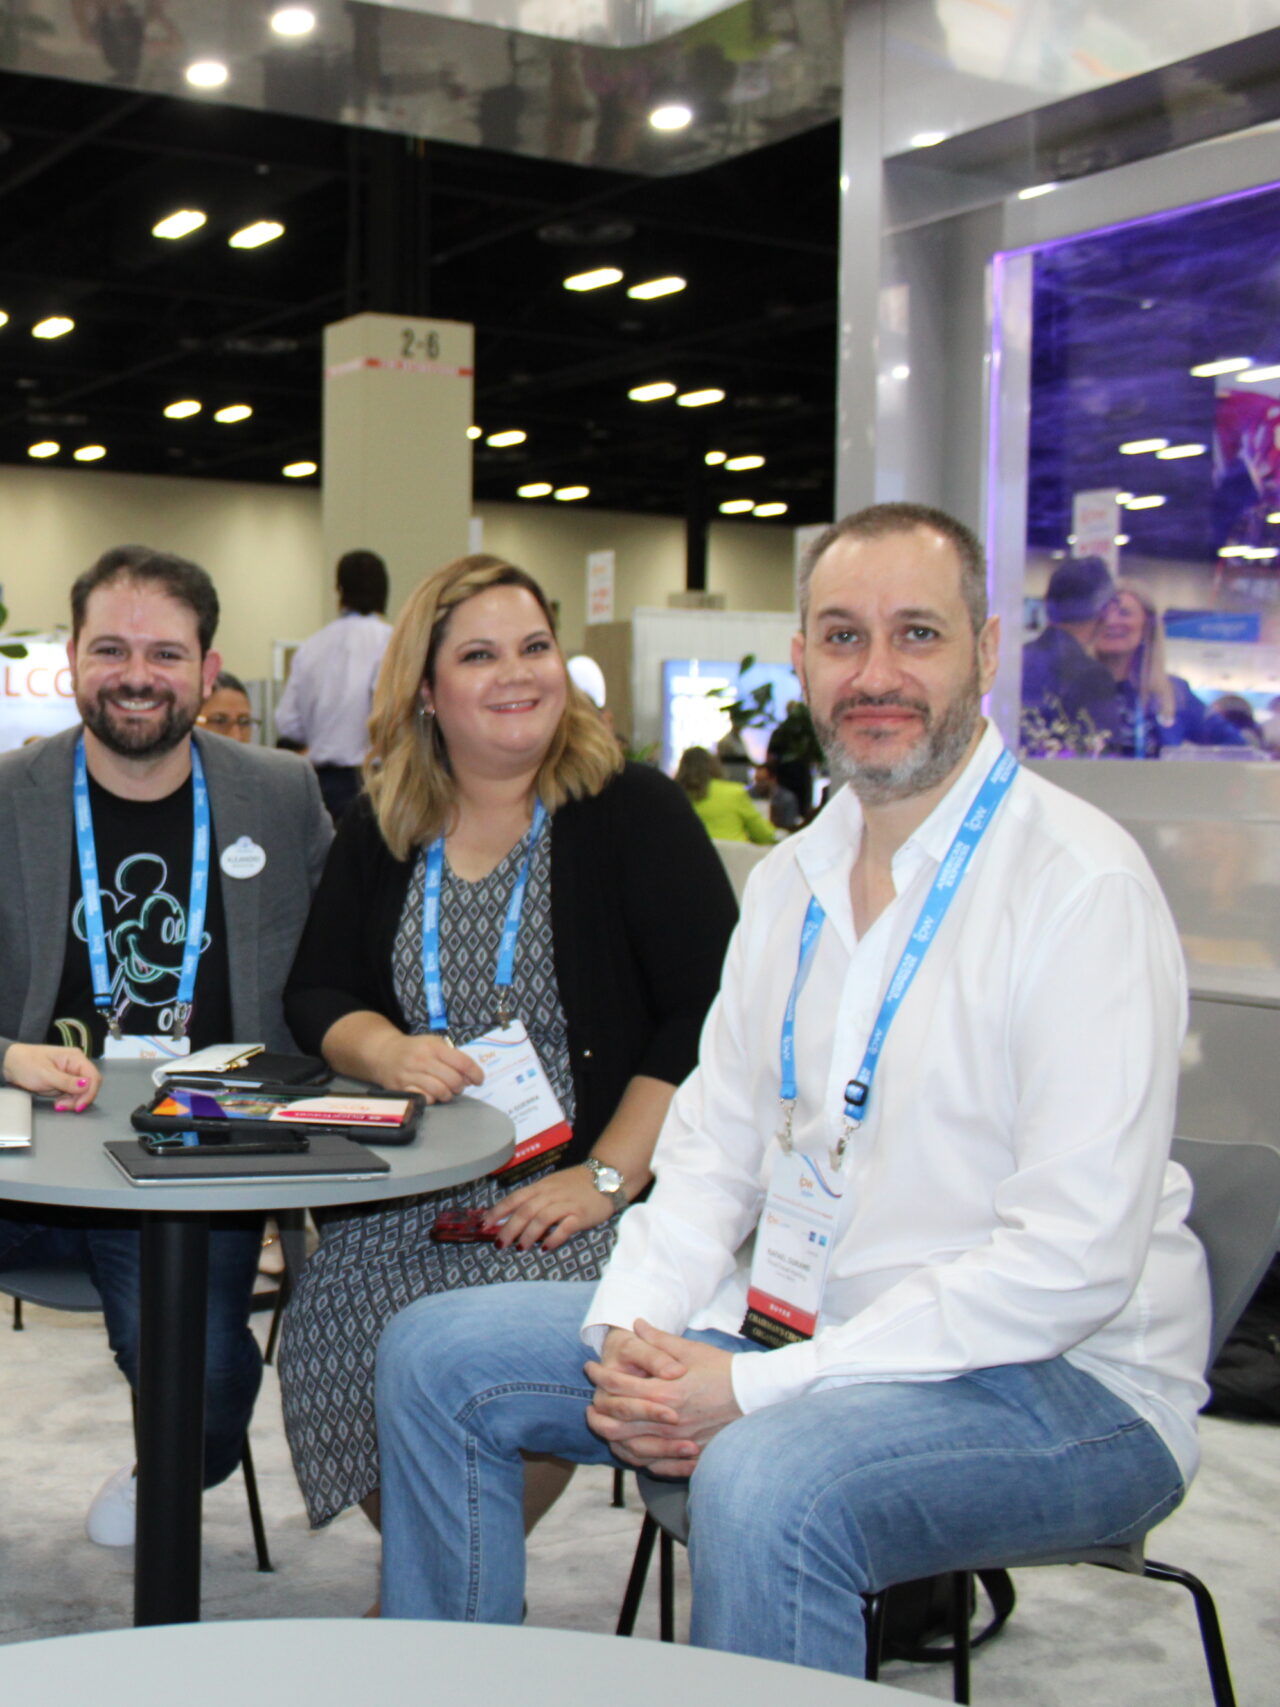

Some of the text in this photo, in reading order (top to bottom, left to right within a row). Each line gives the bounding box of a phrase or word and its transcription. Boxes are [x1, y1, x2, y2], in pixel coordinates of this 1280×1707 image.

[401, 328, 440, 360] 2-6
[963, 805, 987, 832] ipw
[936, 841, 963, 890] AMERICAN
[945, 844, 971, 887] EXPRESS
[912, 915, 934, 942] ipw
[886, 953, 911, 1003] AMERICAN
[893, 956, 918, 999] EXPRESS
